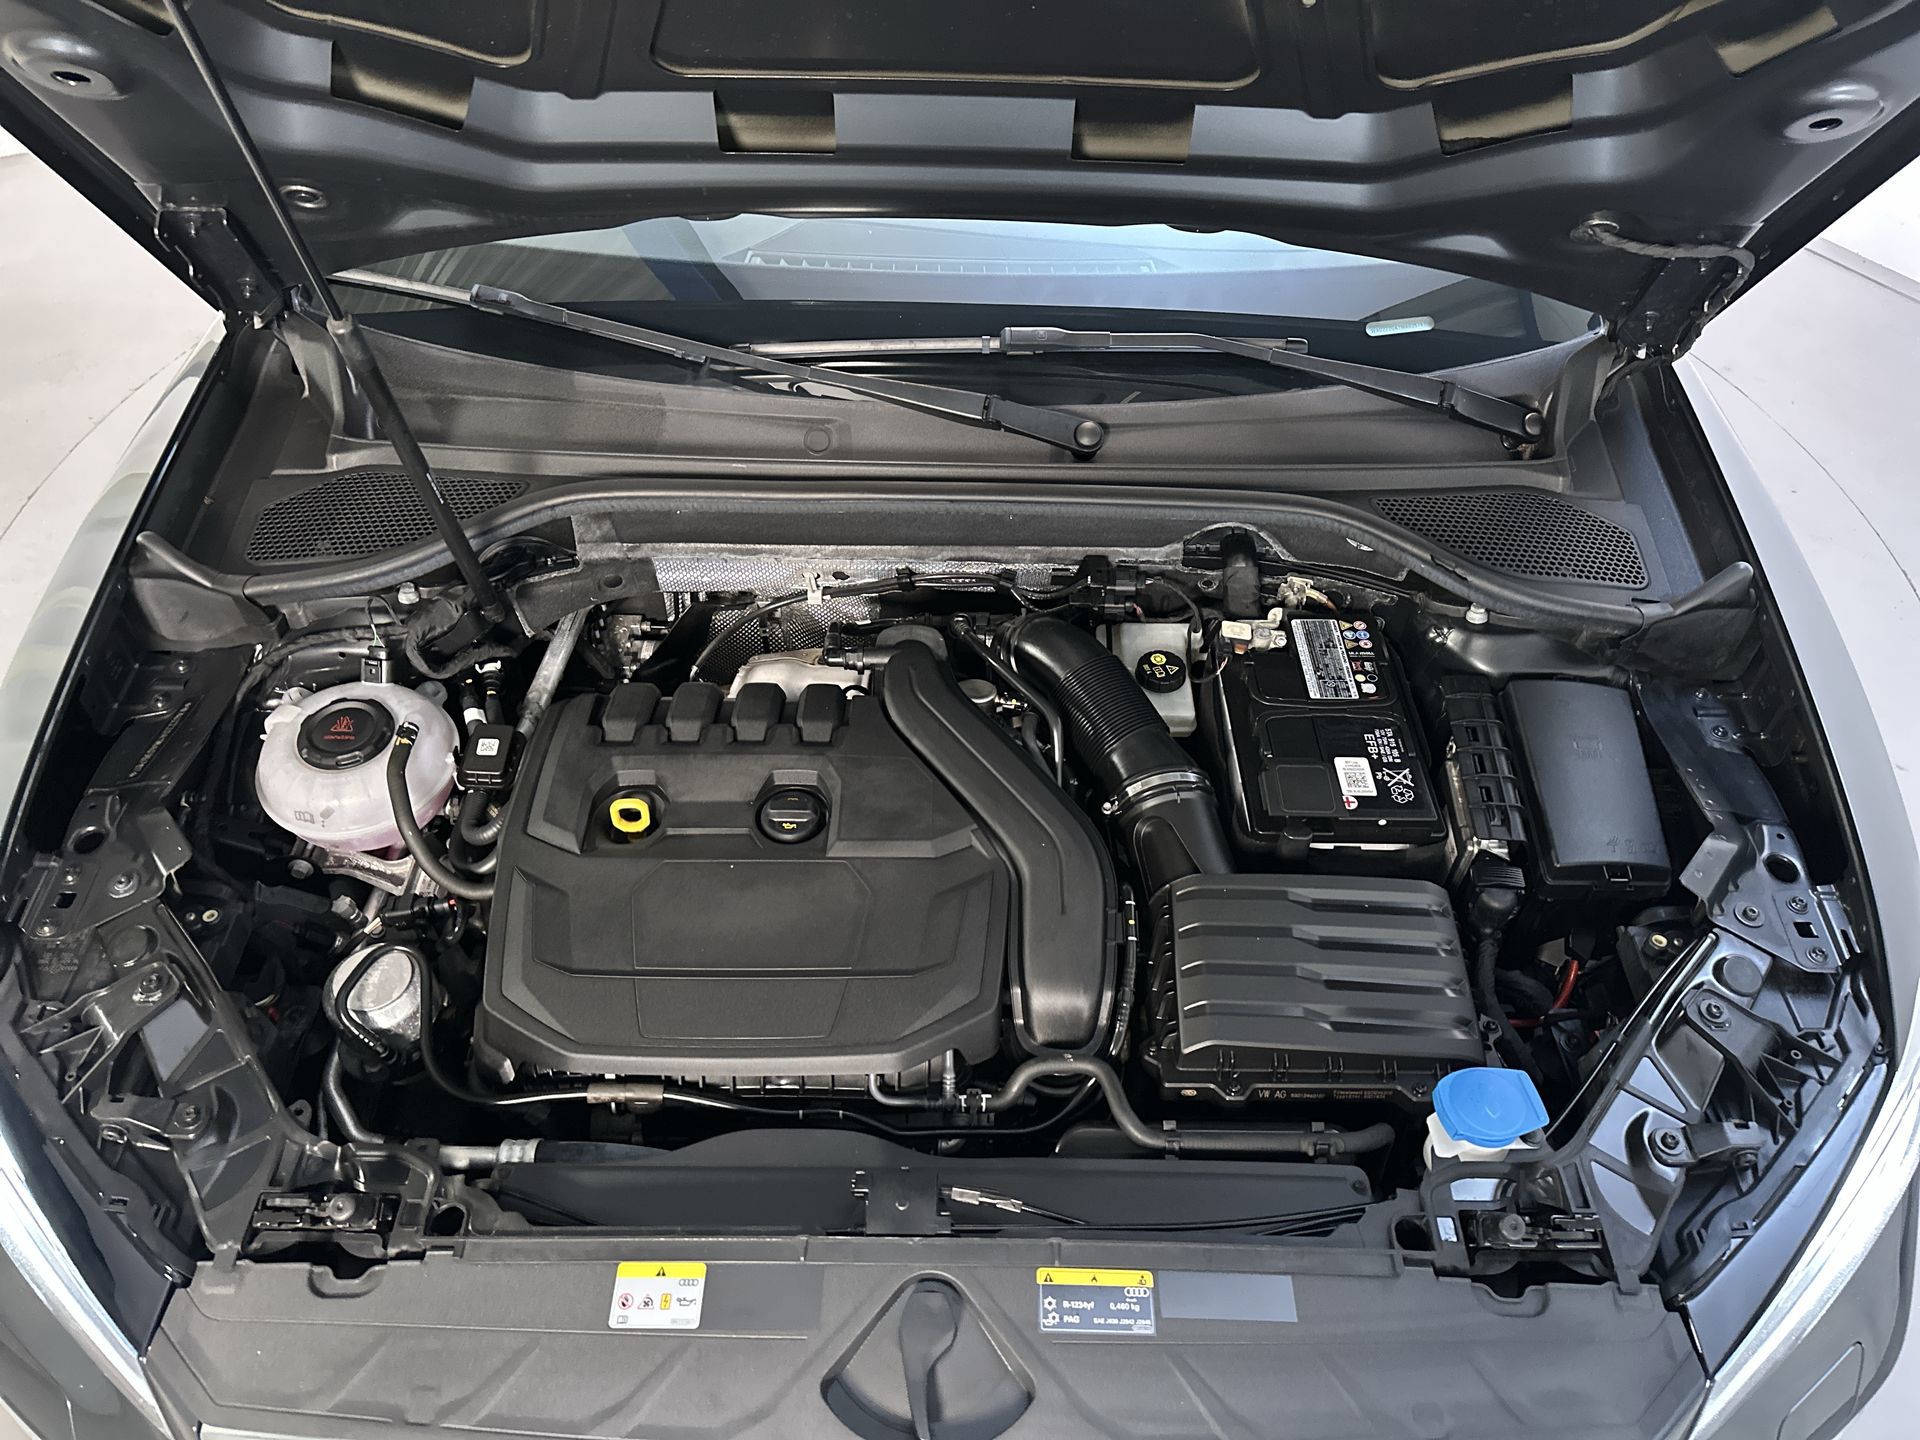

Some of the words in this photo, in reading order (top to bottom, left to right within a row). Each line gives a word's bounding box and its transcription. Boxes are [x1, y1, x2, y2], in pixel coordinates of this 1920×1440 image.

[1363, 733, 1378, 759] EFB+
[1258, 1089, 1270, 1098] VW
[1274, 1090, 1287, 1099] AG
[1063, 1315, 1080, 1324] PAG
